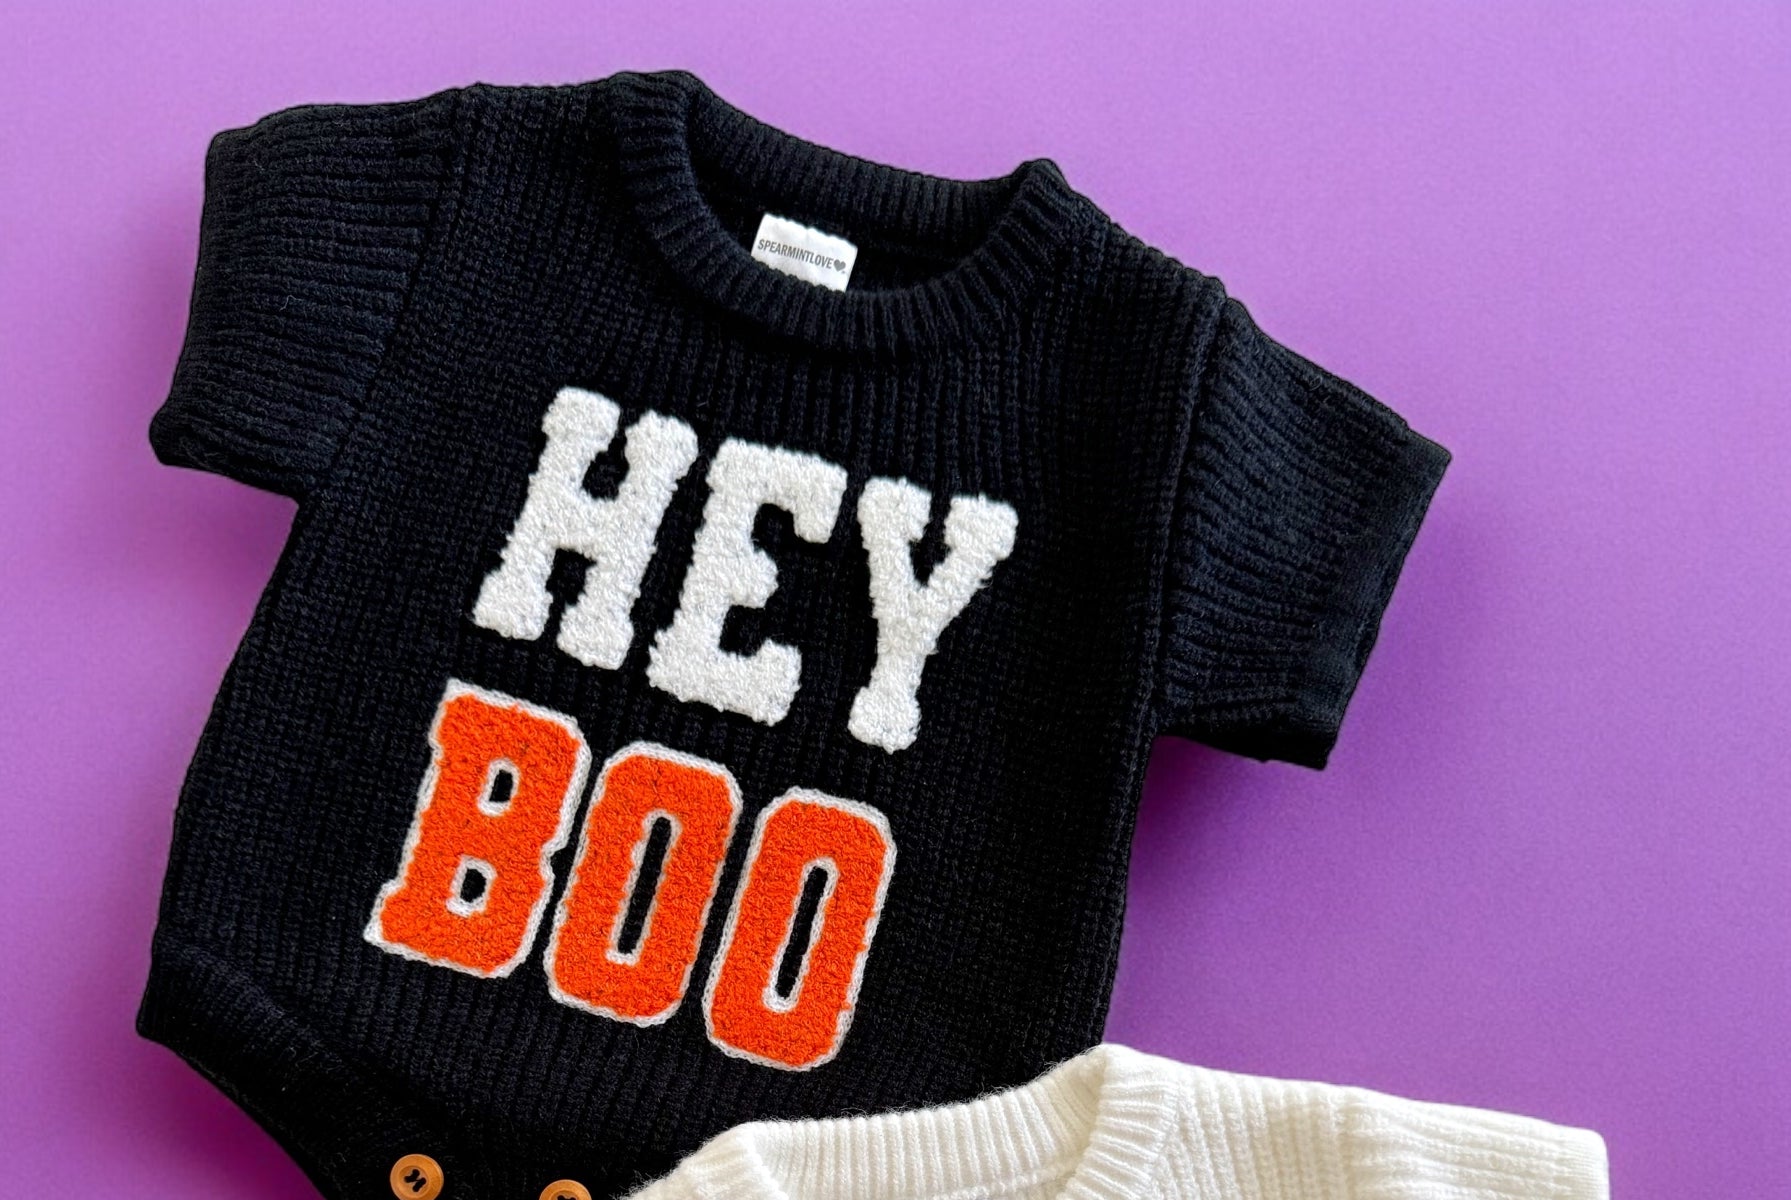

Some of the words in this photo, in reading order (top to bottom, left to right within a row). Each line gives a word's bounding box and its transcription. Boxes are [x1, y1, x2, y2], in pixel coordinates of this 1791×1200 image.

[757, 238, 834, 270] SPEARMINTLOVE
[471, 386, 1018, 754] HEY
[363, 677, 897, 1072] BOO
